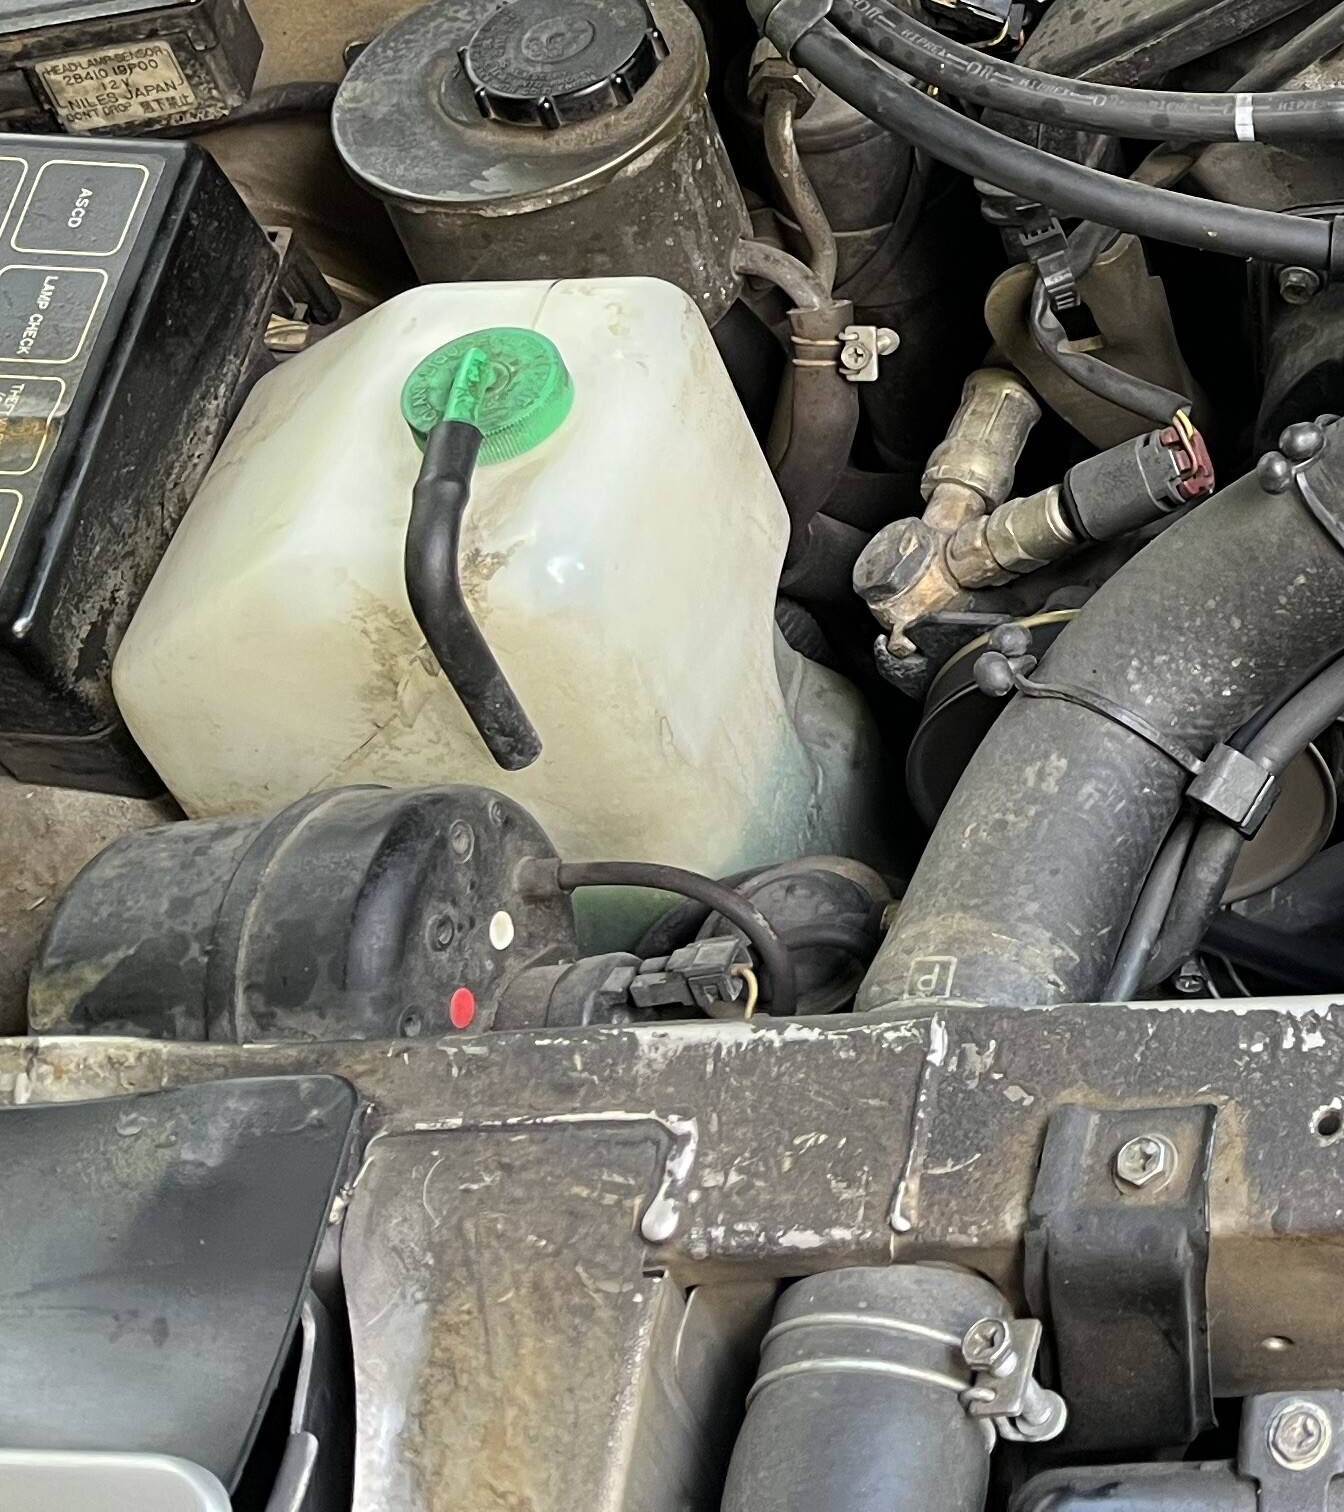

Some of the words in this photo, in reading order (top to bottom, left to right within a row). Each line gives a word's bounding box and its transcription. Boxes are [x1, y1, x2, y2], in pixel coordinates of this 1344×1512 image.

[62, 67, 110, 88] 28410
[67, 92, 119, 112] NILES
[125, 80, 178, 101] JAPAN
[67, 187, 94, 229] ASCD
[37, 274, 59, 310] LAMP
[16, 313, 45, 355] CHECK
